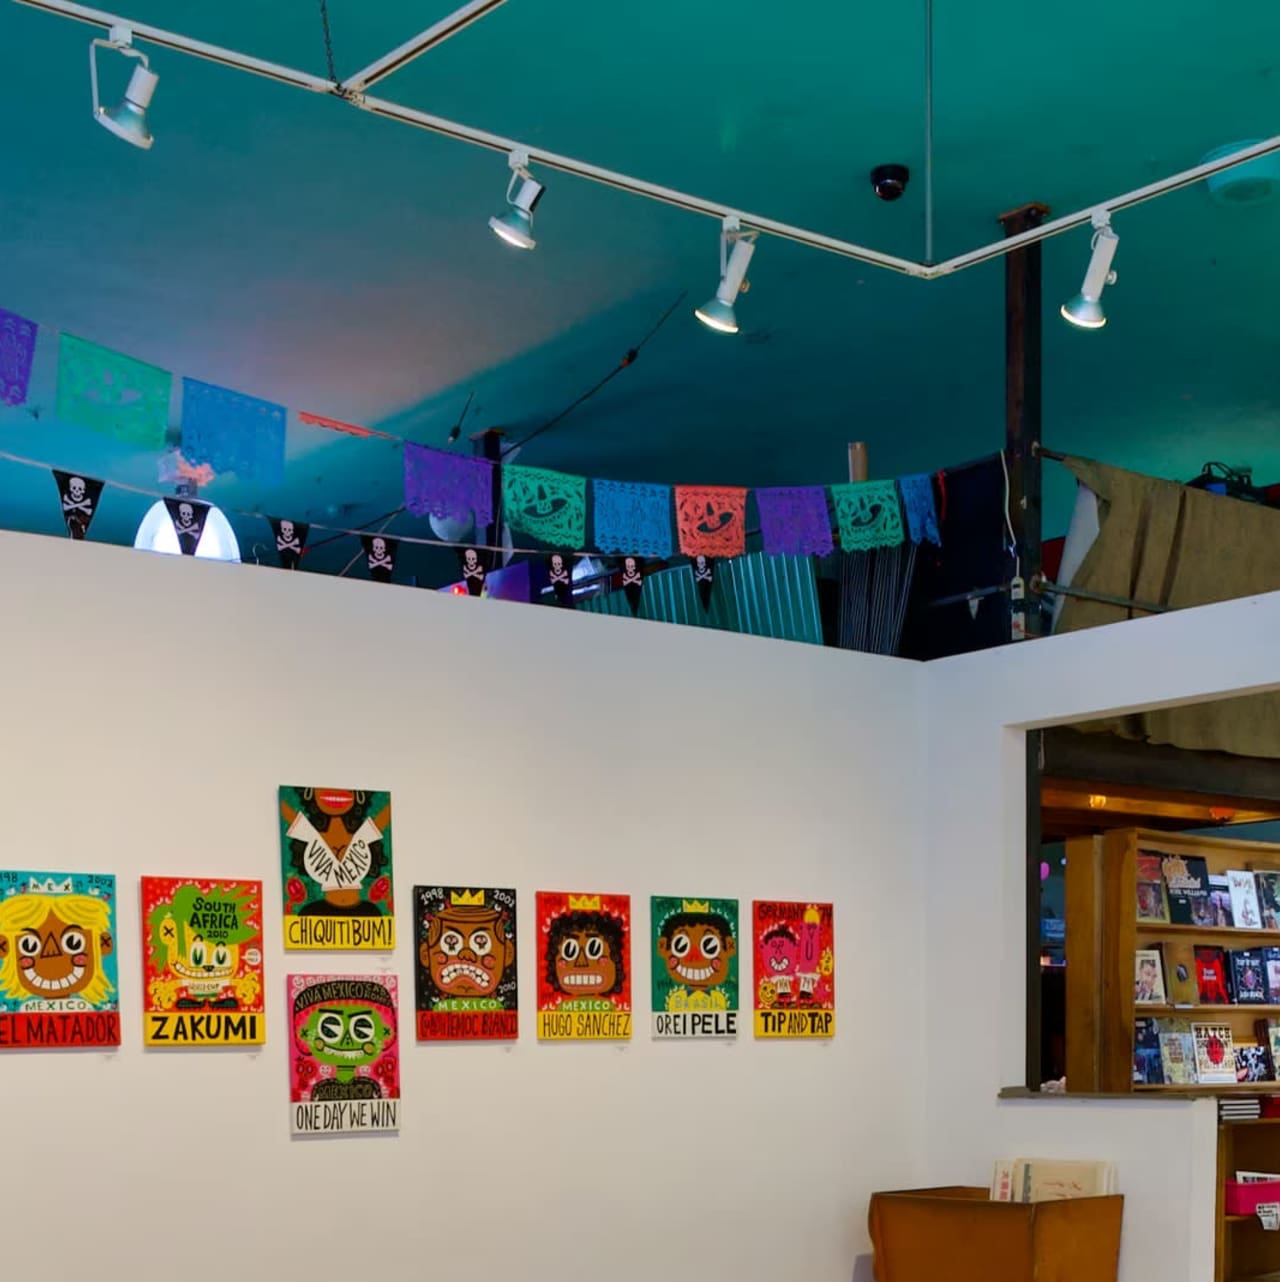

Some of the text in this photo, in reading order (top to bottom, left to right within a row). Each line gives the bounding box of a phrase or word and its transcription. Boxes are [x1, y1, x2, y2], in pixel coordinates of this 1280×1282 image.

[308, 839, 370, 889] VIVA MEXICO
[88, 874, 113, 887] 2002
[421, 887, 444, 903] 1998
[192, 897, 236, 912] SOUTH
[190, 913, 238, 929] AFRICA
[207, 930, 228, 939] 2010
[322, 982, 365, 999] MEXICO
[438, 1000, 498, 1011] MEXICO
[561, 1000, 610, 1011] MEXICO
[26, 1015, 118, 1043] MATADOR
[151, 1015, 257, 1041] ZAKUMI
[543, 1013, 631, 1037] HUGO SANCHEZ
[691, 1013, 736, 1035] PELE
[788, 1013, 808, 1033] AND
[809, 1012, 832, 1033] TAP
[296, 1102, 397, 1130] ONE DAY WE WIN
